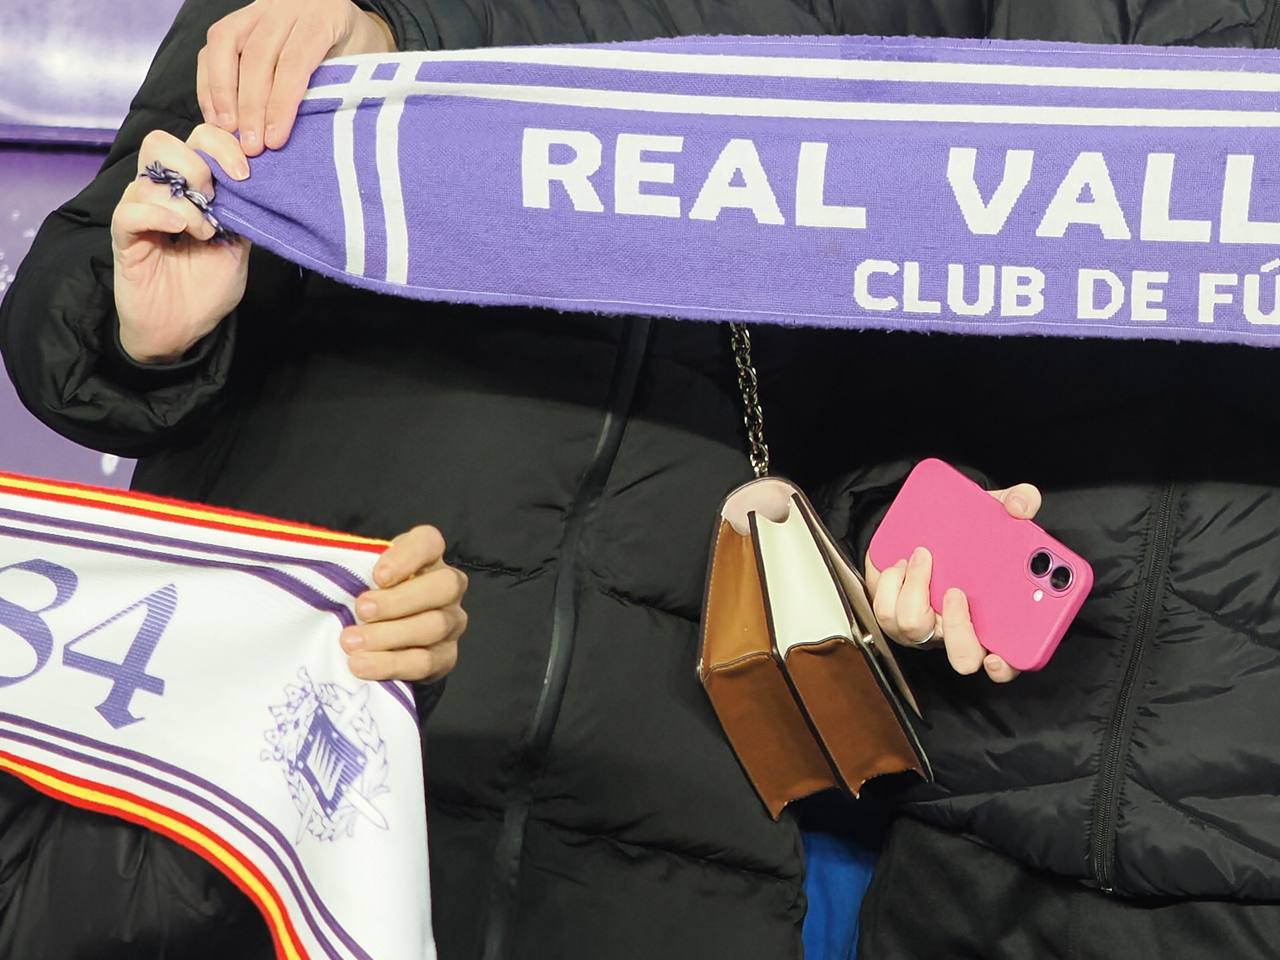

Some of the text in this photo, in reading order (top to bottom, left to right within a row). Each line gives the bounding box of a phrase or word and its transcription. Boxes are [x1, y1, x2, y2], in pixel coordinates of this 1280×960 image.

[520, 127, 869, 230] REAL
[853, 258, 1047, 318] CLUB
[1075, 267, 1172, 325] DE
